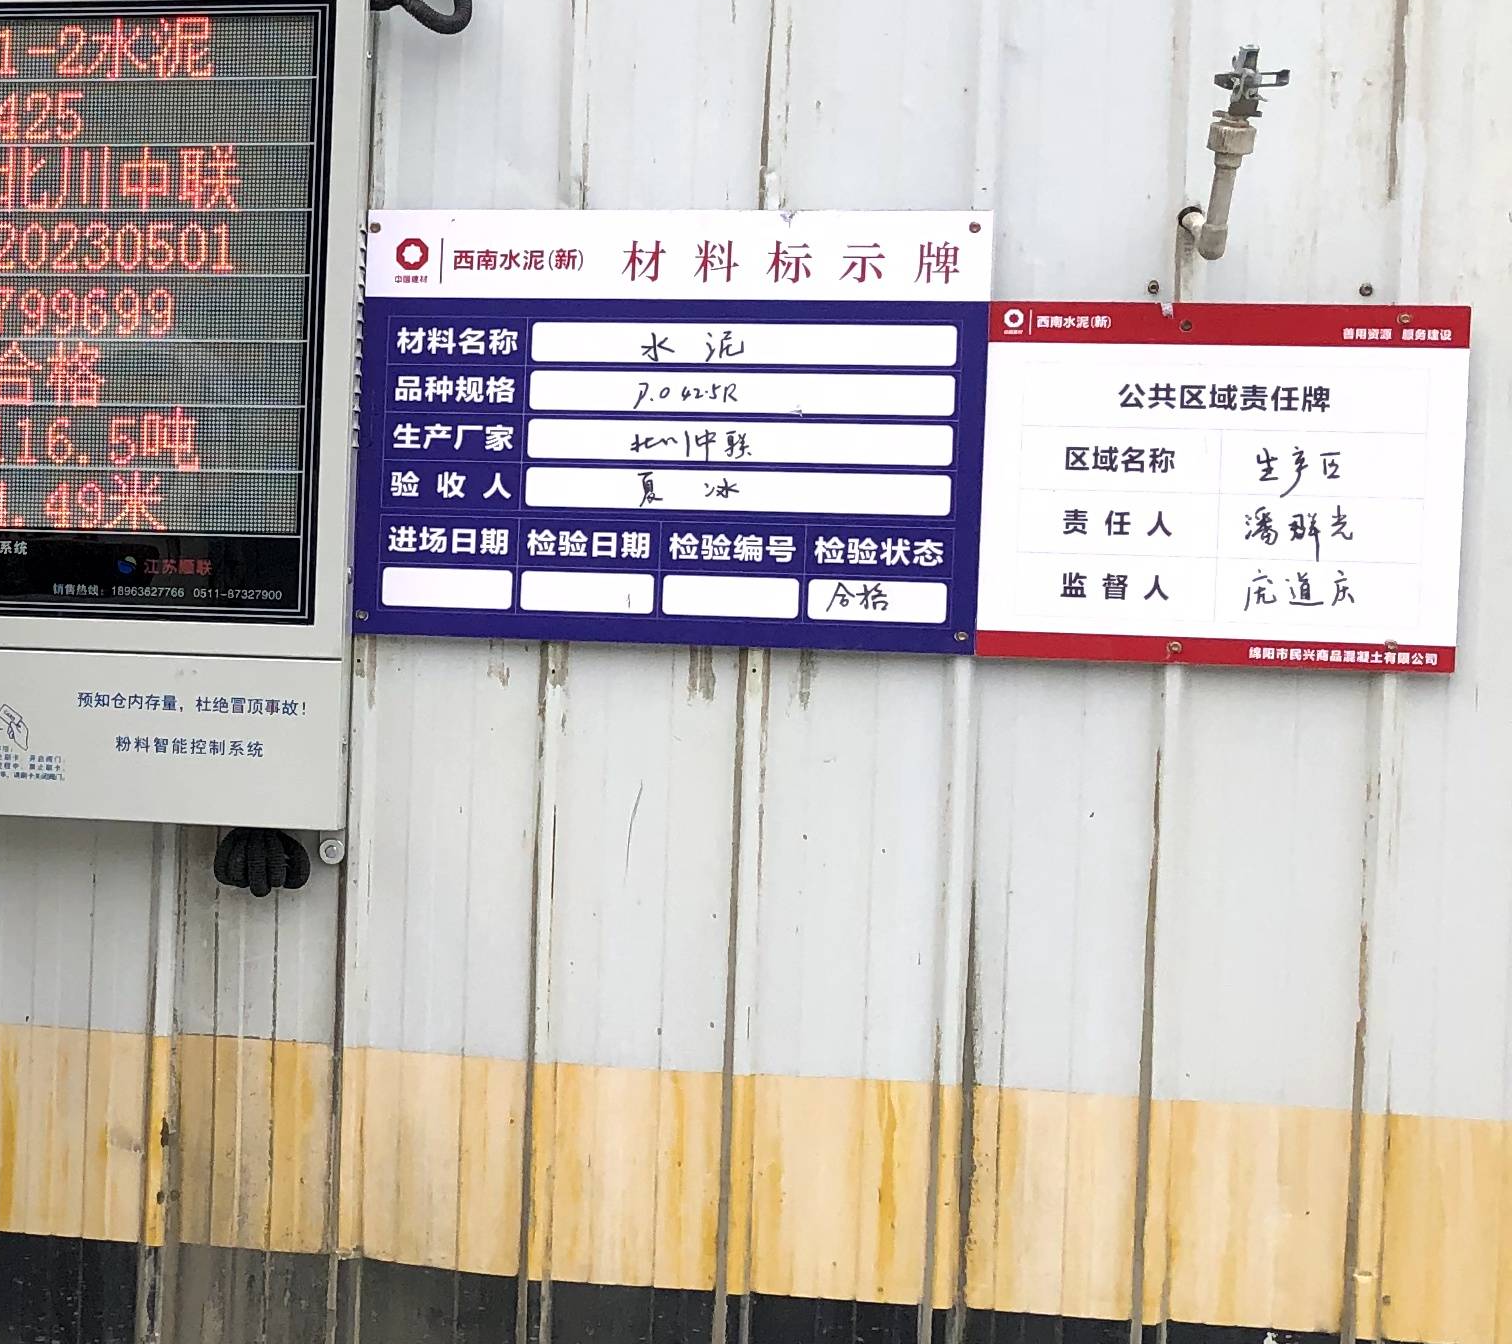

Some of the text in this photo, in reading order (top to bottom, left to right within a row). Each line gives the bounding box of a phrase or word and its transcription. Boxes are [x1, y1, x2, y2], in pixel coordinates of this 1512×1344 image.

[453, 248, 584, 272] 西南水泥(新)
[620, 240, 961, 285] 材料标示牌
[1036, 315, 1112, 329] 西南水泥(新)
[1342, 327, 1452, 341] 善用资源 服务建设
[395, 327, 518, 356] 材料名称
[640, 330, 745, 363] 水泥
[394, 375, 516, 404] 品种规格
[1118, 382, 1331, 413] 公共区域责任牌
[392, 422, 515, 452] 生产厂家
[1065, 446, 1175, 473] 区域名称
[390, 472, 513, 500] 验收人
[1063, 509, 1172, 537] 责任人
[388, 525, 945, 567] 进场日期 检验日期 检验编号 检验状态
[193, 587, 283, 600] 0511-87327900
[826, 582, 890, 612] 合格
[1060, 572, 1169, 600] 监督人
[1248, 646, 1439, 666] 绵阳市民兴商品混凝土有限公司
[115, 735, 264, 758] 粉料智能控制系统
